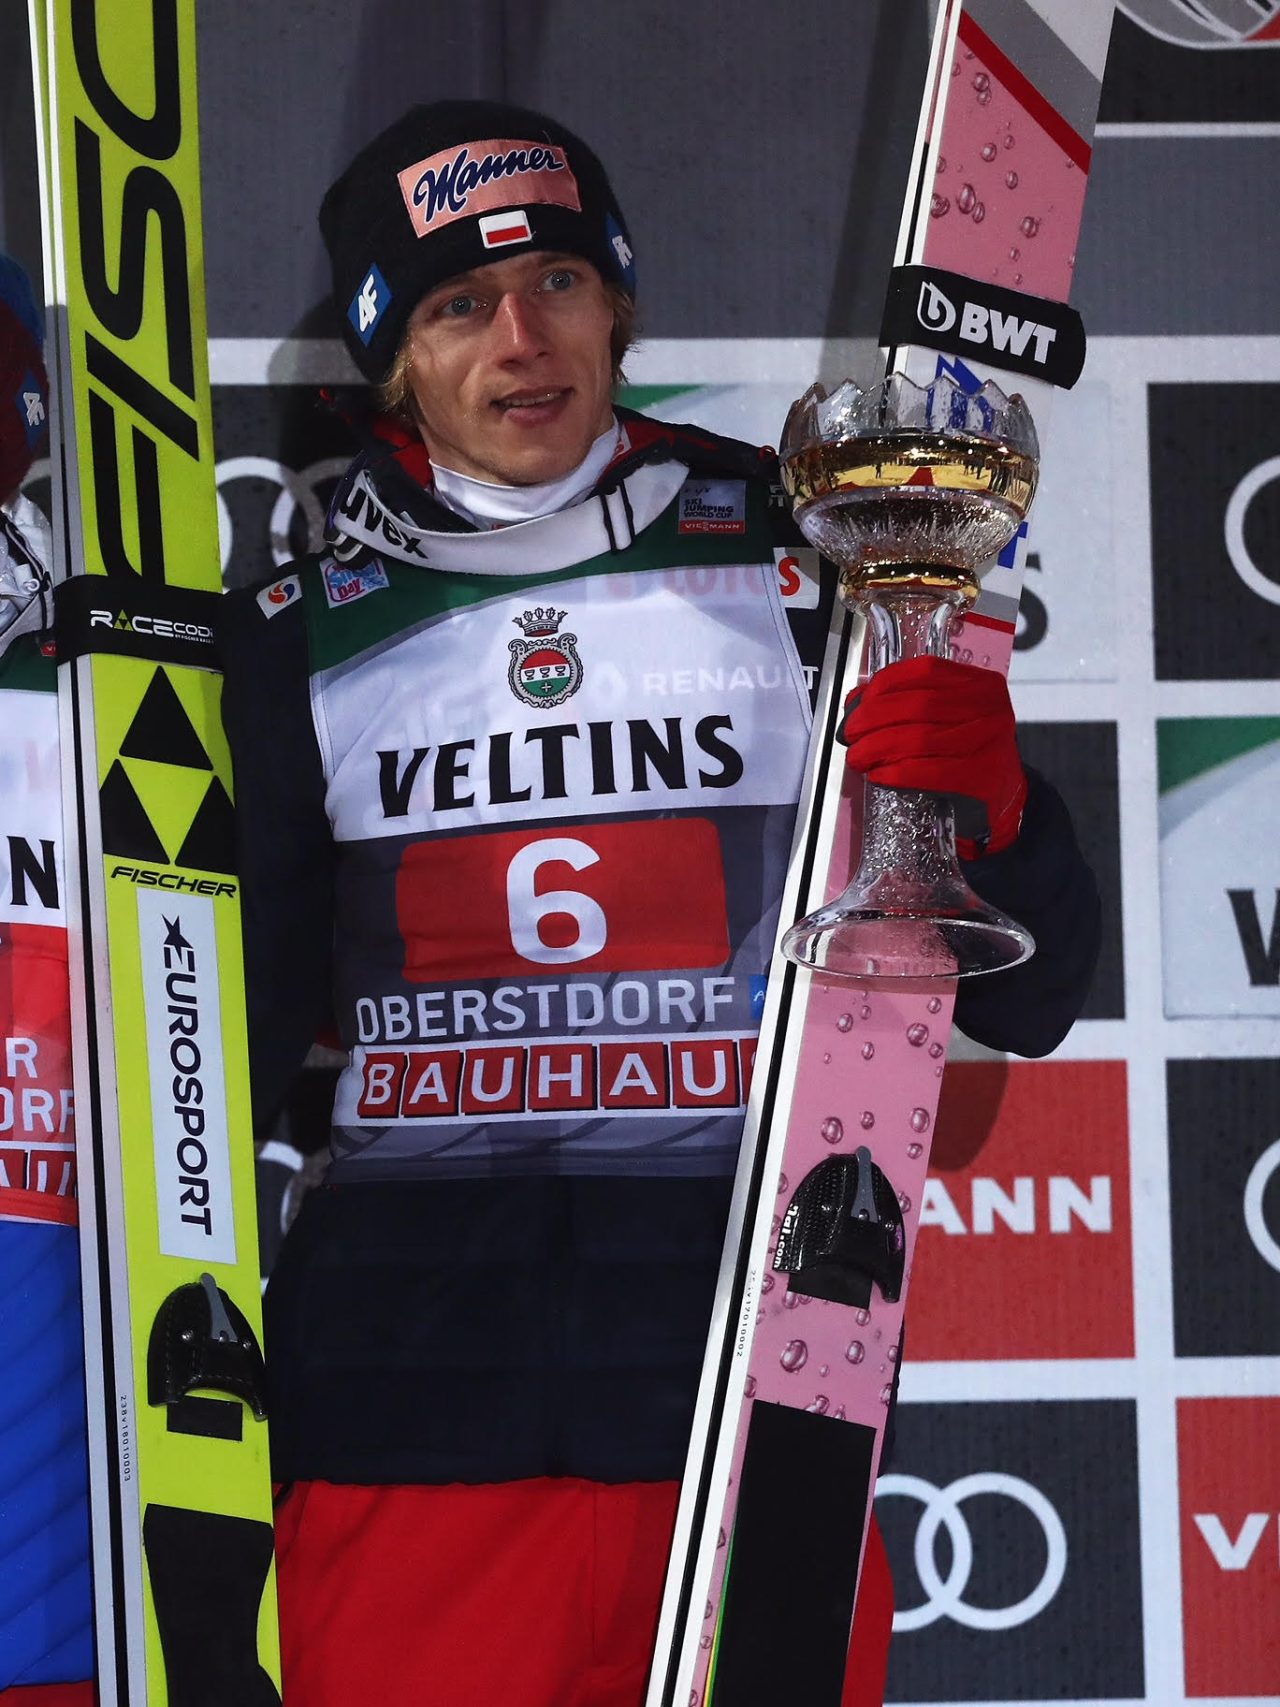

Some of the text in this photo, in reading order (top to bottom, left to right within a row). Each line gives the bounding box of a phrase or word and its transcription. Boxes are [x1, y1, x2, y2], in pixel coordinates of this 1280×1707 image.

[413, 147, 565, 223] Manner
[358, 274, 377, 332] 4F
[959, 302, 1057, 364] BWT
[340, 487, 429, 559] uvex
[684, 505, 734, 513] JUMPING
[376, 714, 744, 818] VELTINS
[111, 866, 237, 898] FISCHER
[506, 837, 608, 964] 6
[356, 976, 736, 1043] OBERSTDORF
[163, 925, 212, 1236] EUROSPORT
[365, 1049, 756, 1106] BAUHAU
